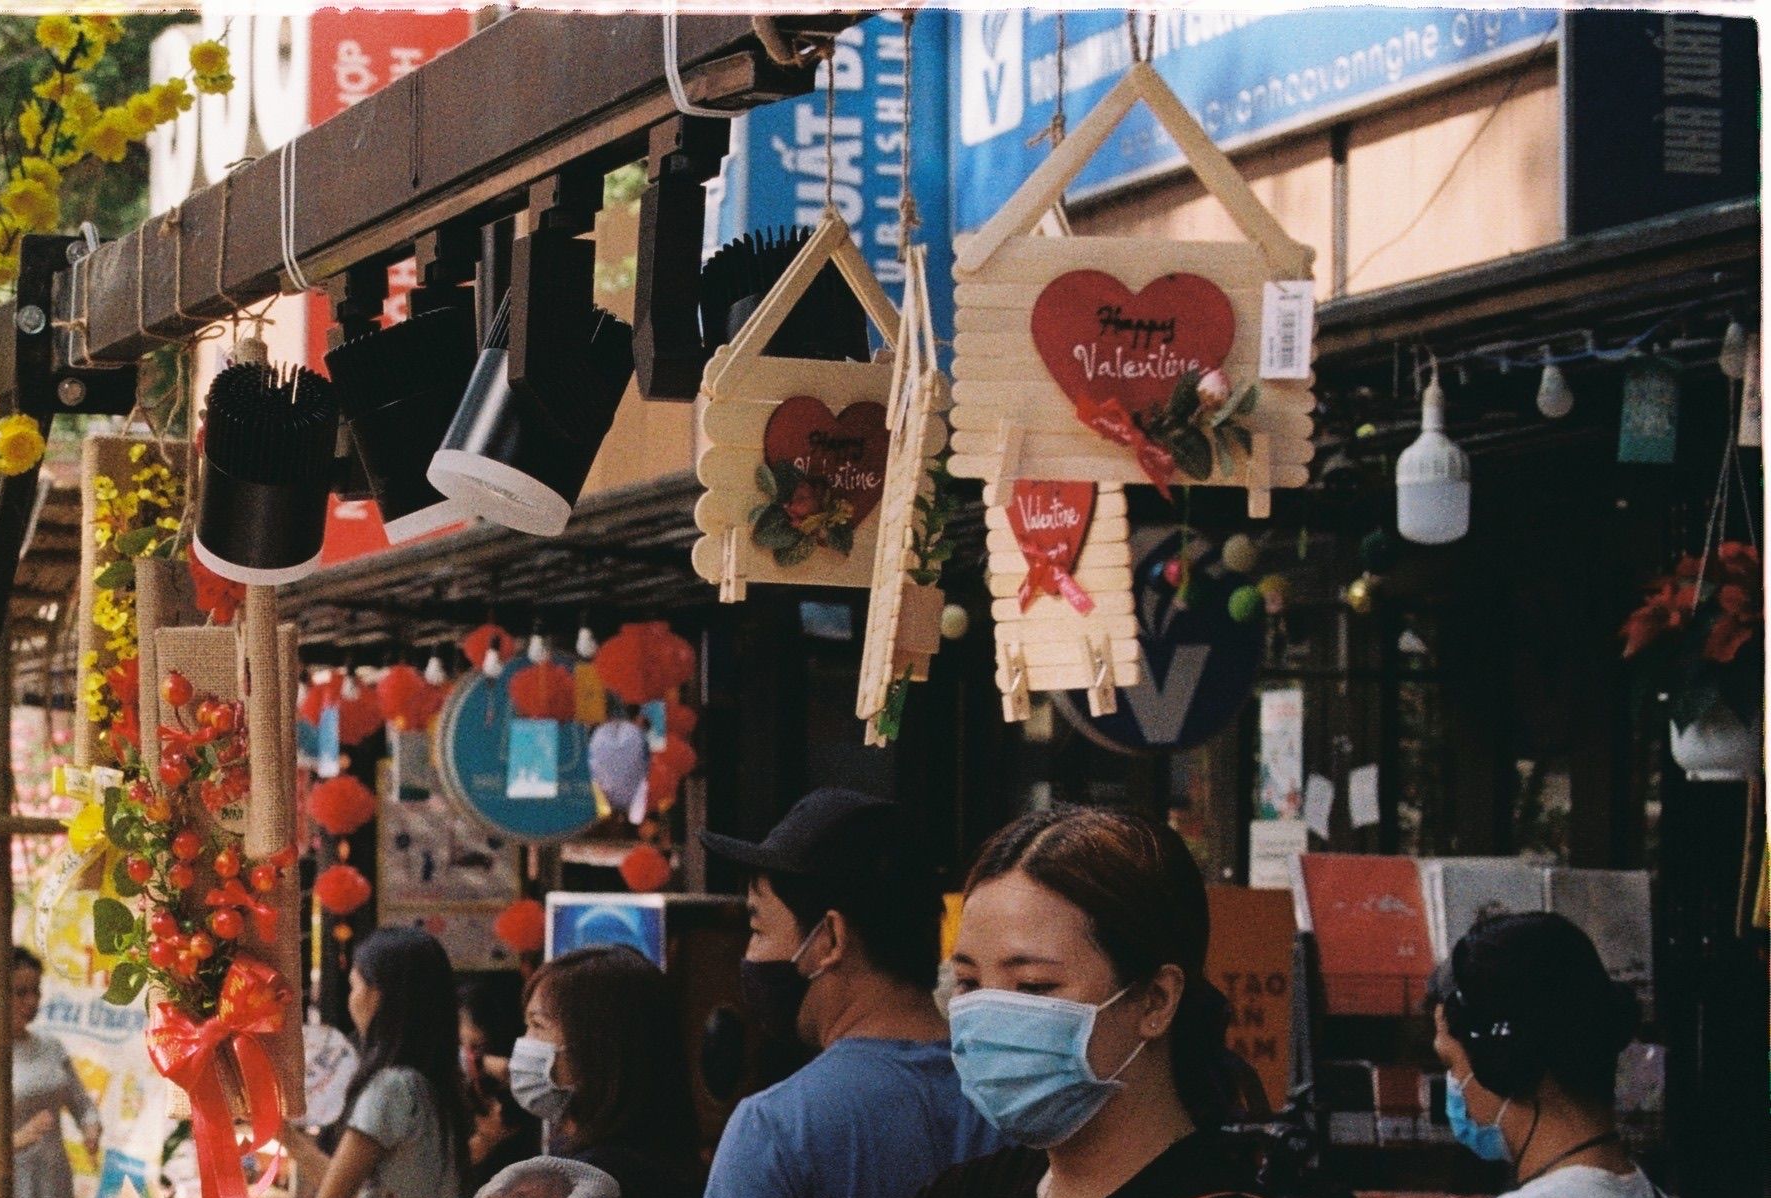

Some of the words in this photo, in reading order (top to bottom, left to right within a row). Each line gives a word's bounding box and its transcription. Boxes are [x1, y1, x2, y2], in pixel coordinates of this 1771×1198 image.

[875, 10, 910, 284] UBLISHIN
[1652, 105, 1722, 175] NHÀ
[772, 102, 864, 248] UẤT
[1097, 304, 1177, 350] Happy
[1073, 342, 1210, 382] Valentine
[1017, 495, 1081, 532] Valentine
